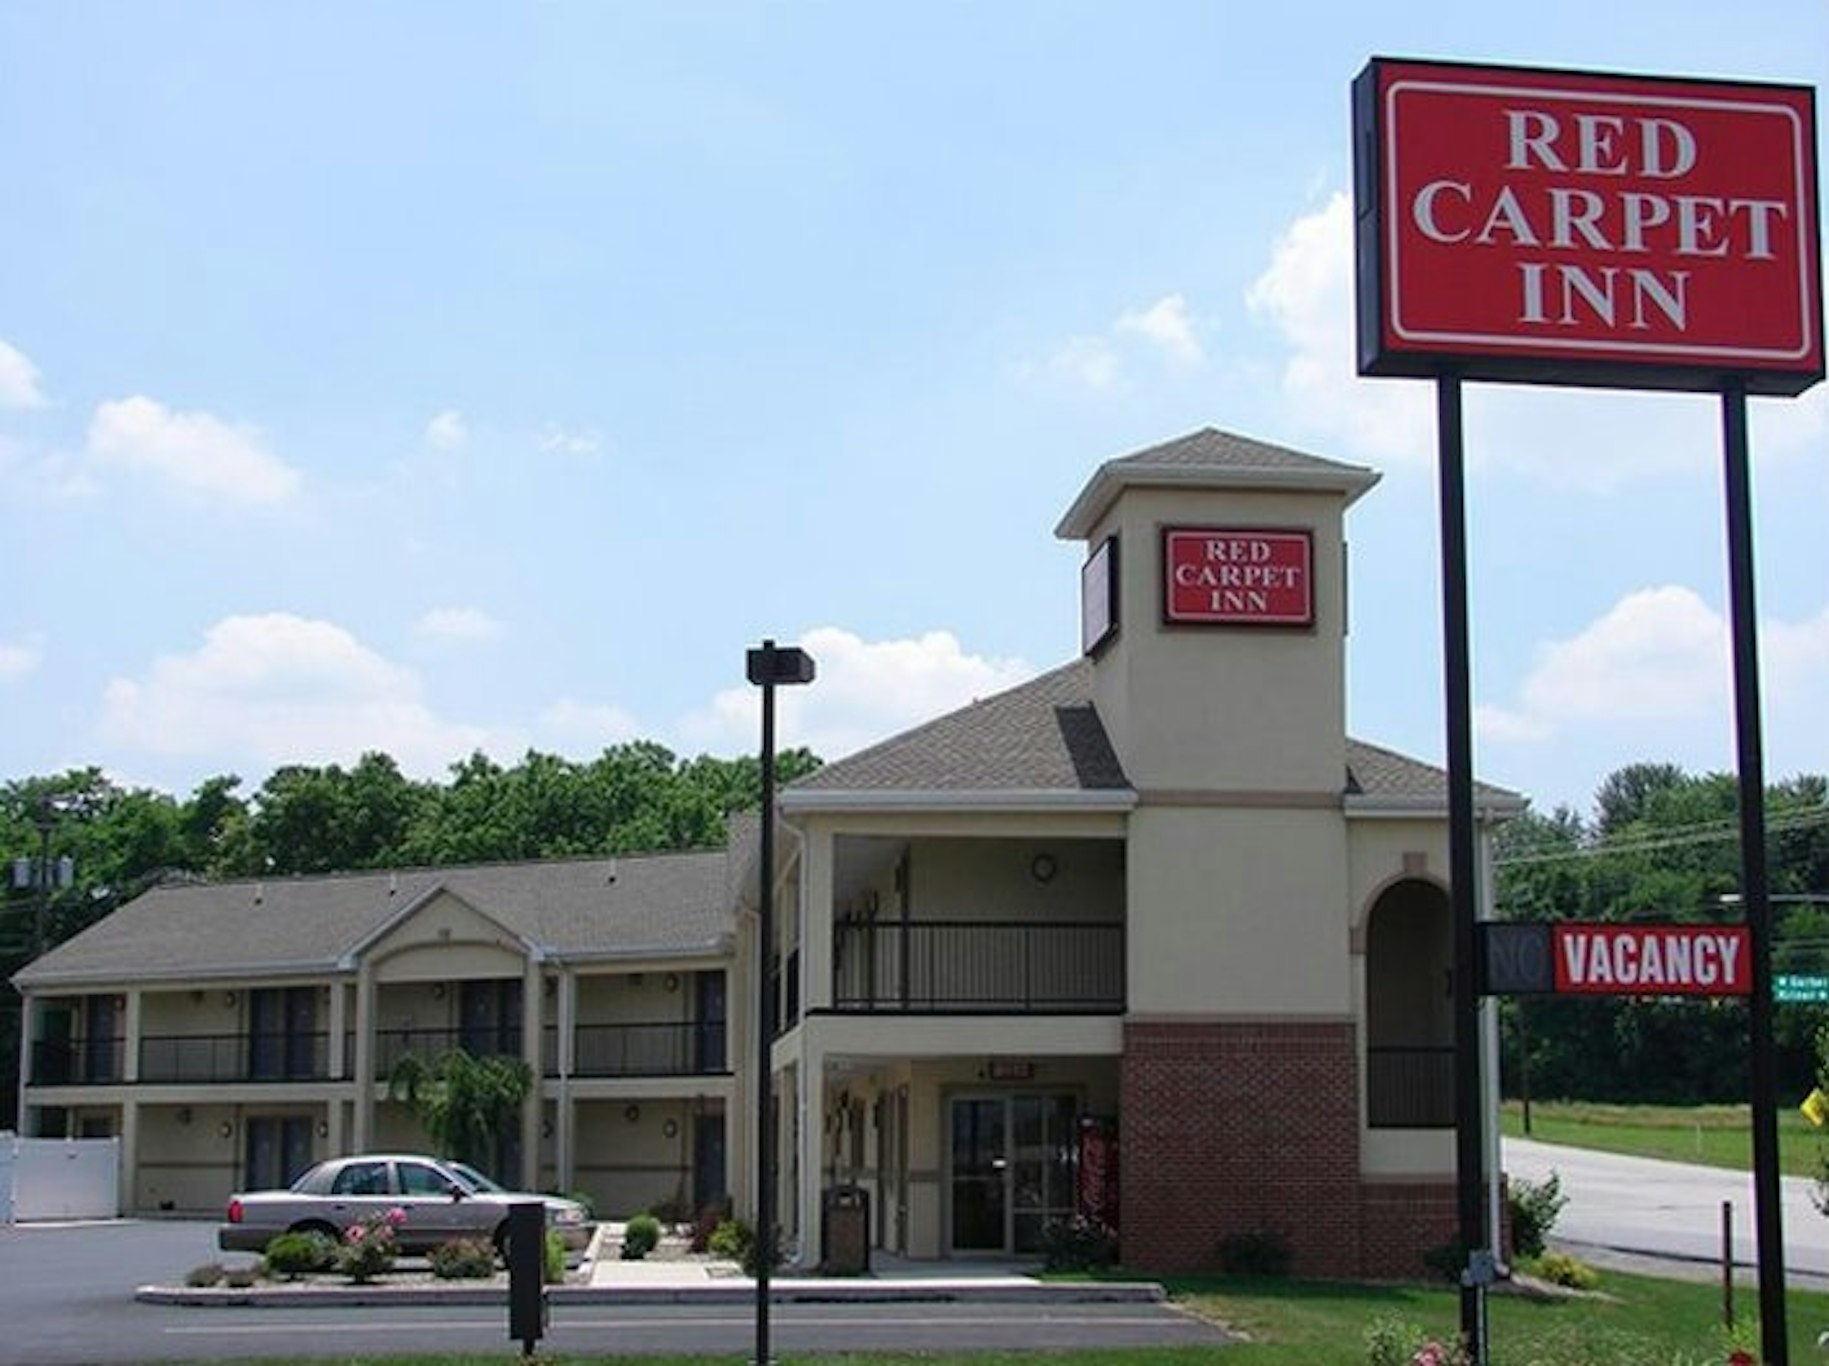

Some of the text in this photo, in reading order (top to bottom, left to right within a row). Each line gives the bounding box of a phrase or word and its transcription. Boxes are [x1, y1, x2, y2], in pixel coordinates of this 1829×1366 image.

[1503, 109, 1698, 179] RED
[1412, 179, 1788, 260] CARPET
[1517, 261, 1691, 332] INN
[1175, 563, 1301, 588] CARPET
[1205, 539, 1271, 562] RED
[1210, 589, 1268, 612] INN
[1562, 933, 1741, 985] VACANCY
